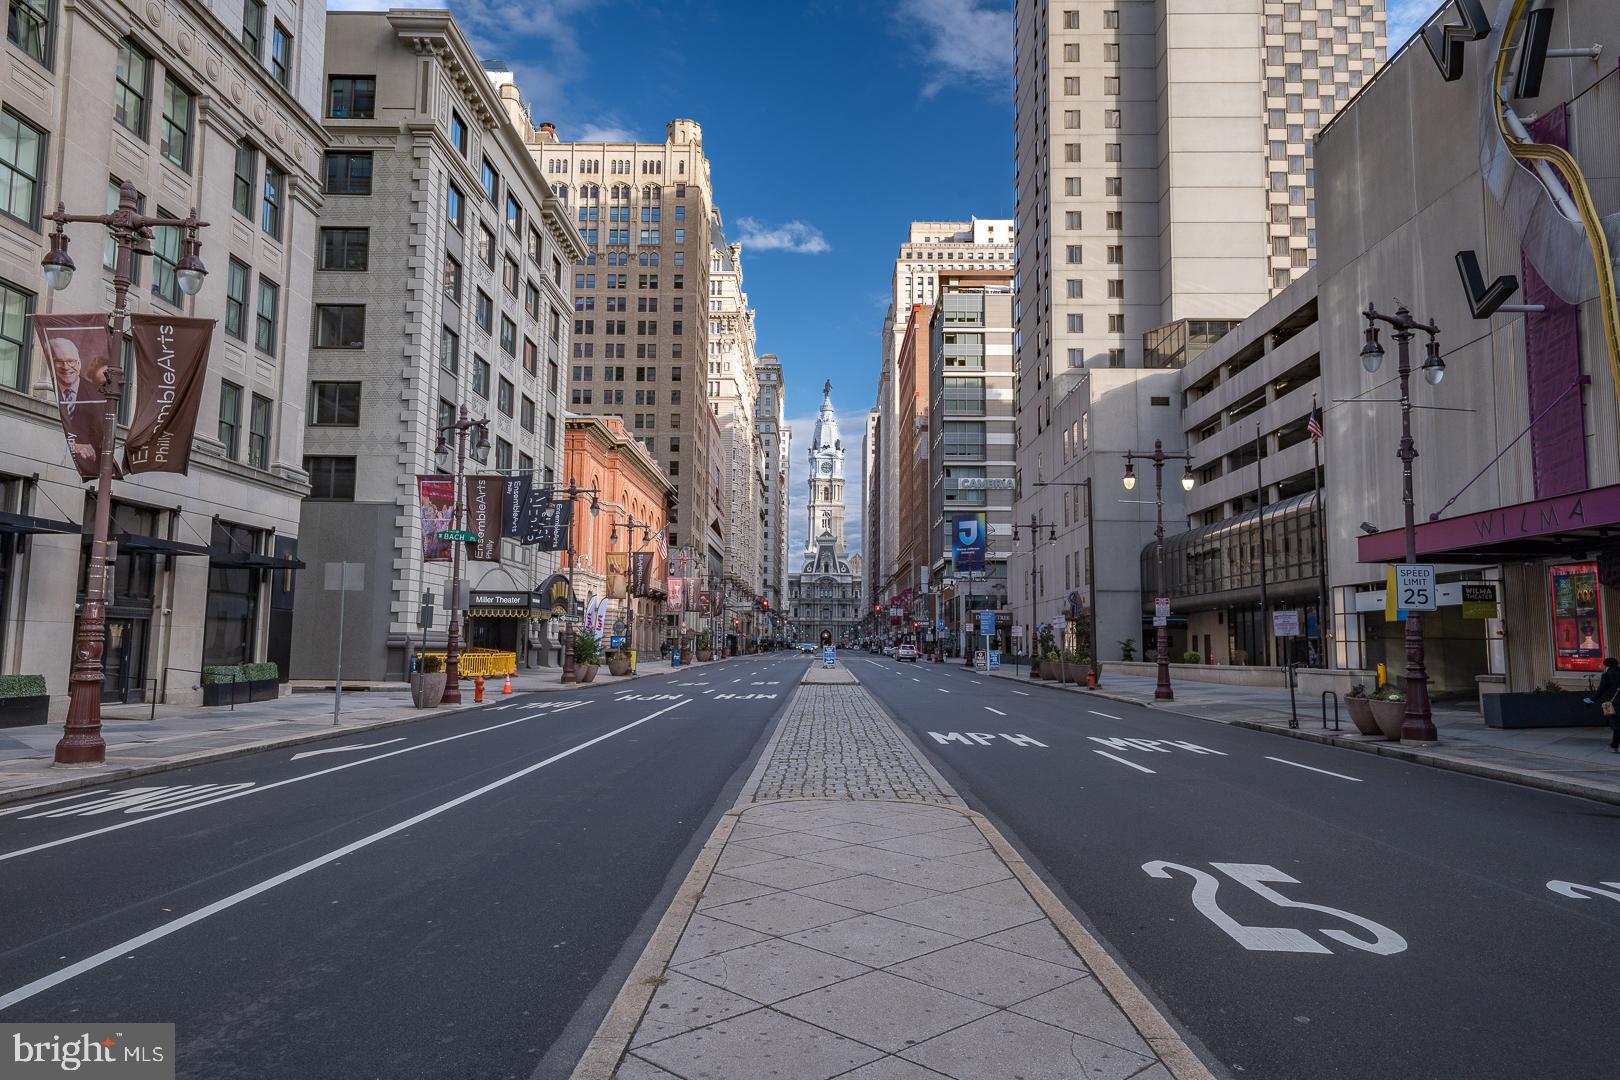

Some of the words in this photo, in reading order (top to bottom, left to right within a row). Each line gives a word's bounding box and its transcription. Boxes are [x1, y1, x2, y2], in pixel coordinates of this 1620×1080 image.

[511, 481, 521, 532] EnsembleArts
[475, 480, 486, 559] EnsembleArts
[1473, 496, 1586, 538] WILMA
[444, 533, 465, 541] BACH
[486, 540, 495, 559] Philly
[1400, 569, 1430, 577] SPEED
[1403, 578, 1428, 586] LIMIT
[1404, 588, 1429, 604] 25
[927, 731, 1049, 748] MPH
[1087, 736, 1229, 755] MPH
[1141, 859, 1409, 956] 25
